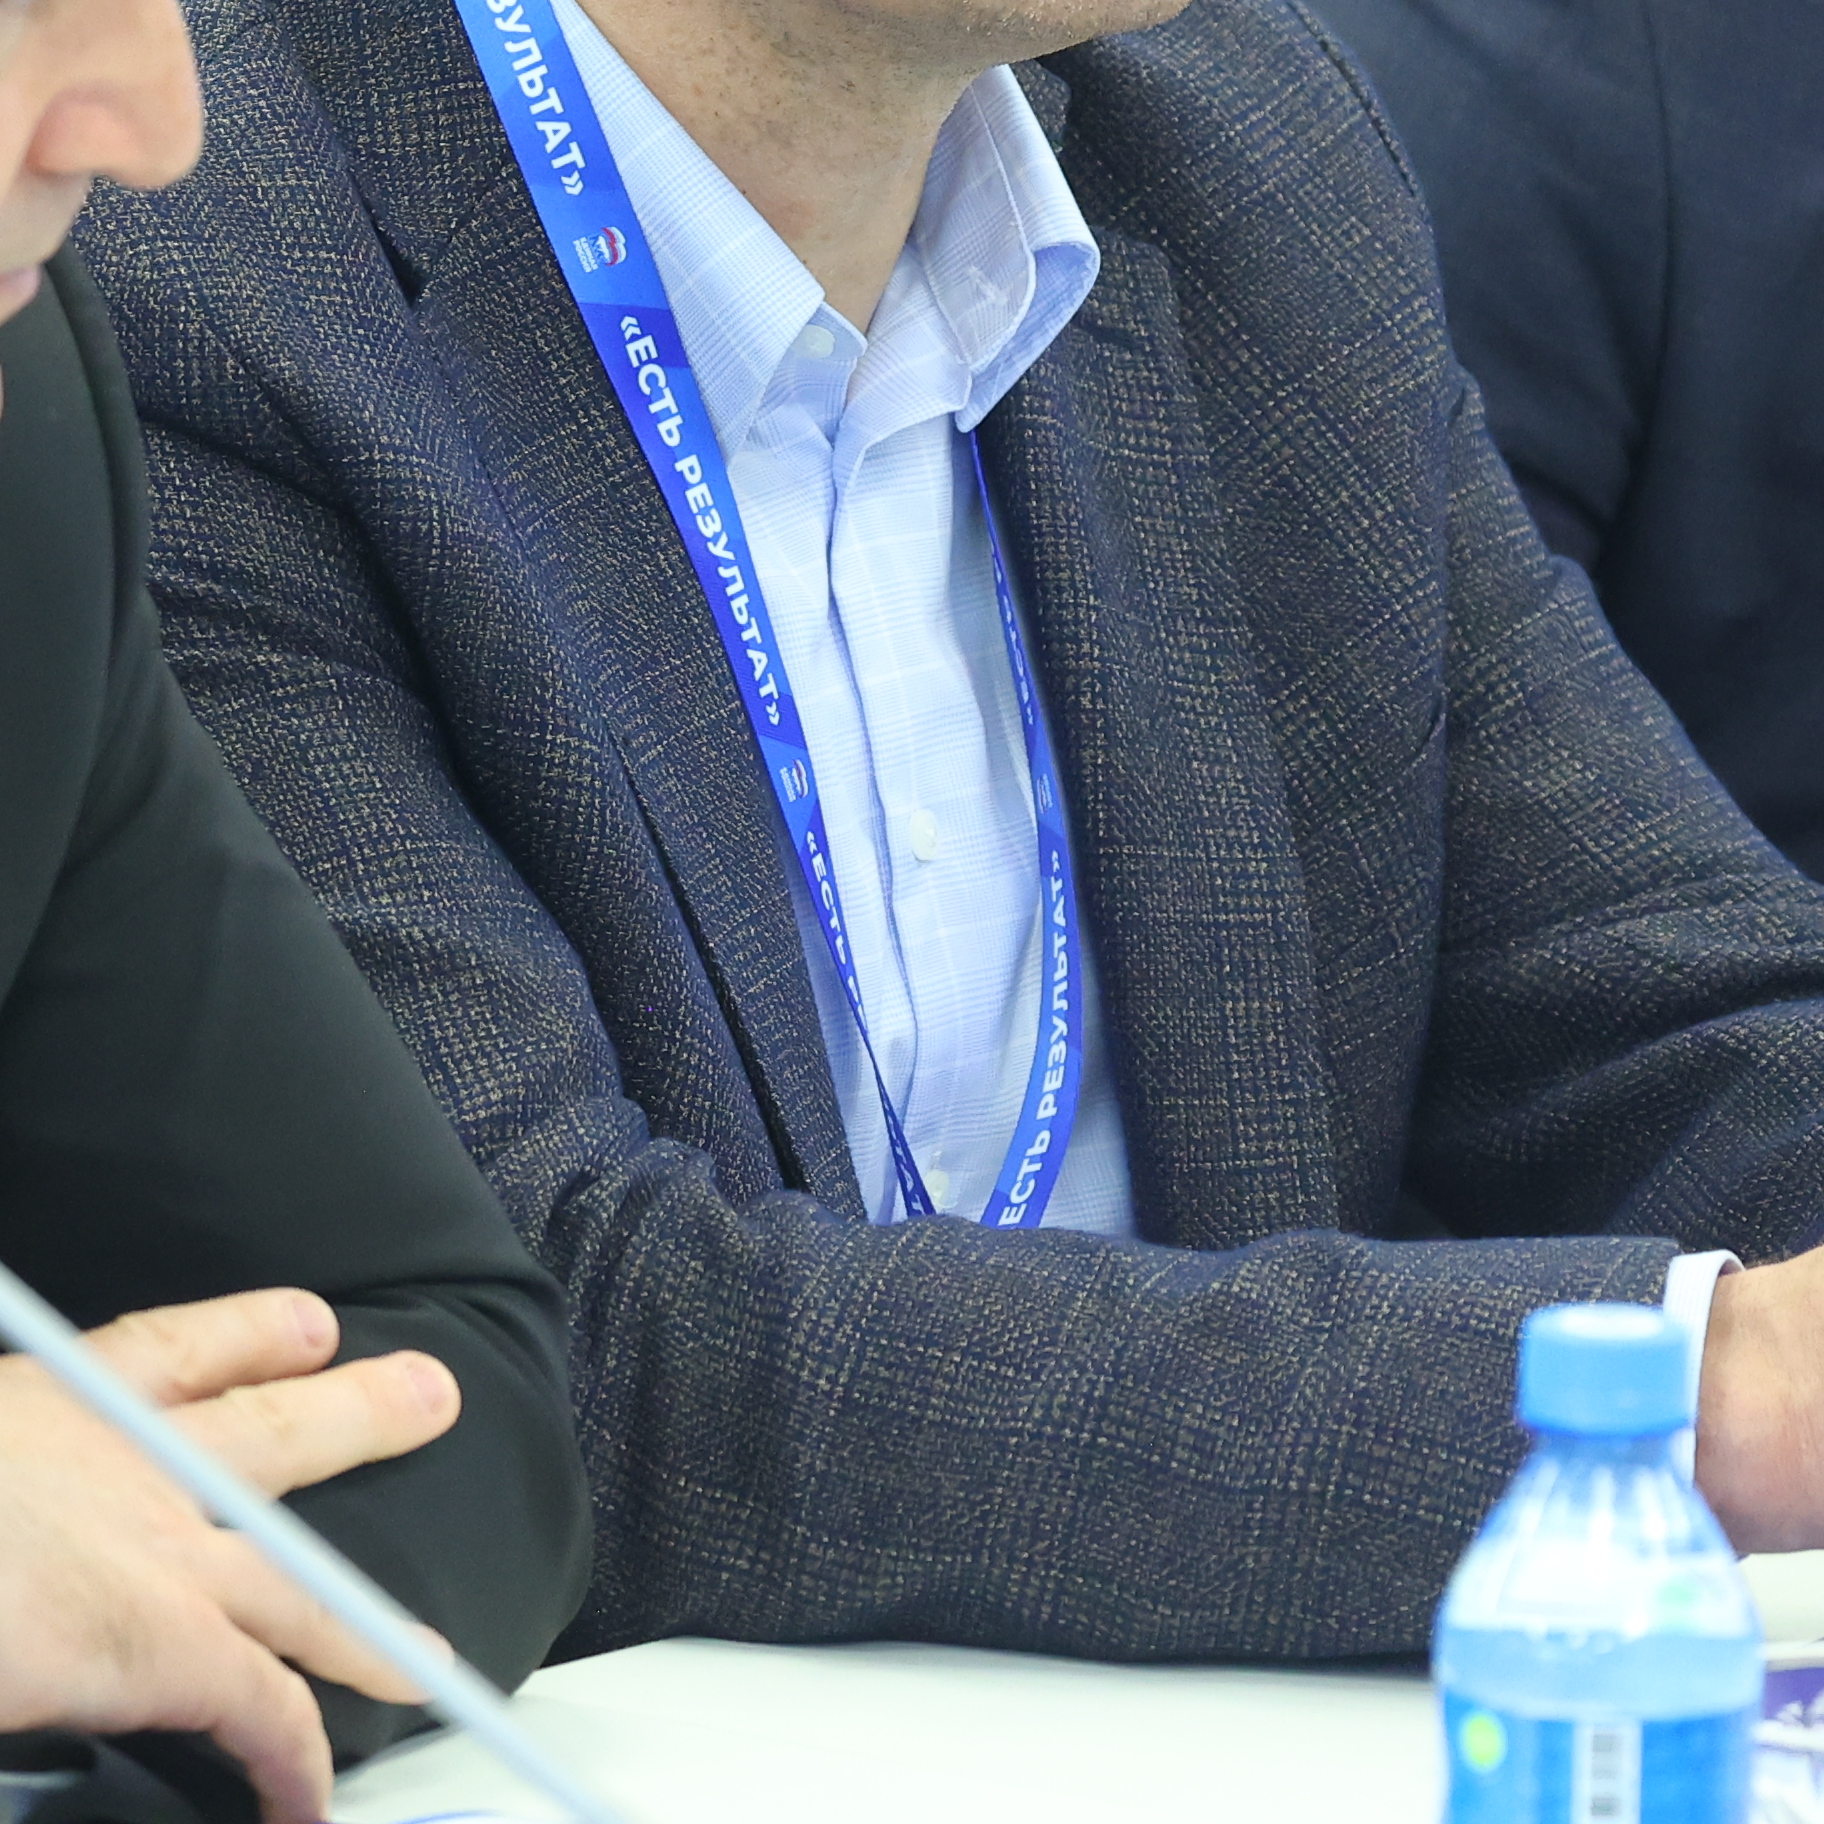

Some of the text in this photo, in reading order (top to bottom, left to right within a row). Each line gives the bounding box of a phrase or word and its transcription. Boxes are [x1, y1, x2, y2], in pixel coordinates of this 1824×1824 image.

[620, 315, 781, 727] «ЕСТЬ РЕЗУЛЬТАТ»
[806, 830, 847, 965] «ЕСТЬ
[999, 849, 1070, 1226] ЕСТЬ РЕЗУЛЬТАТ»
